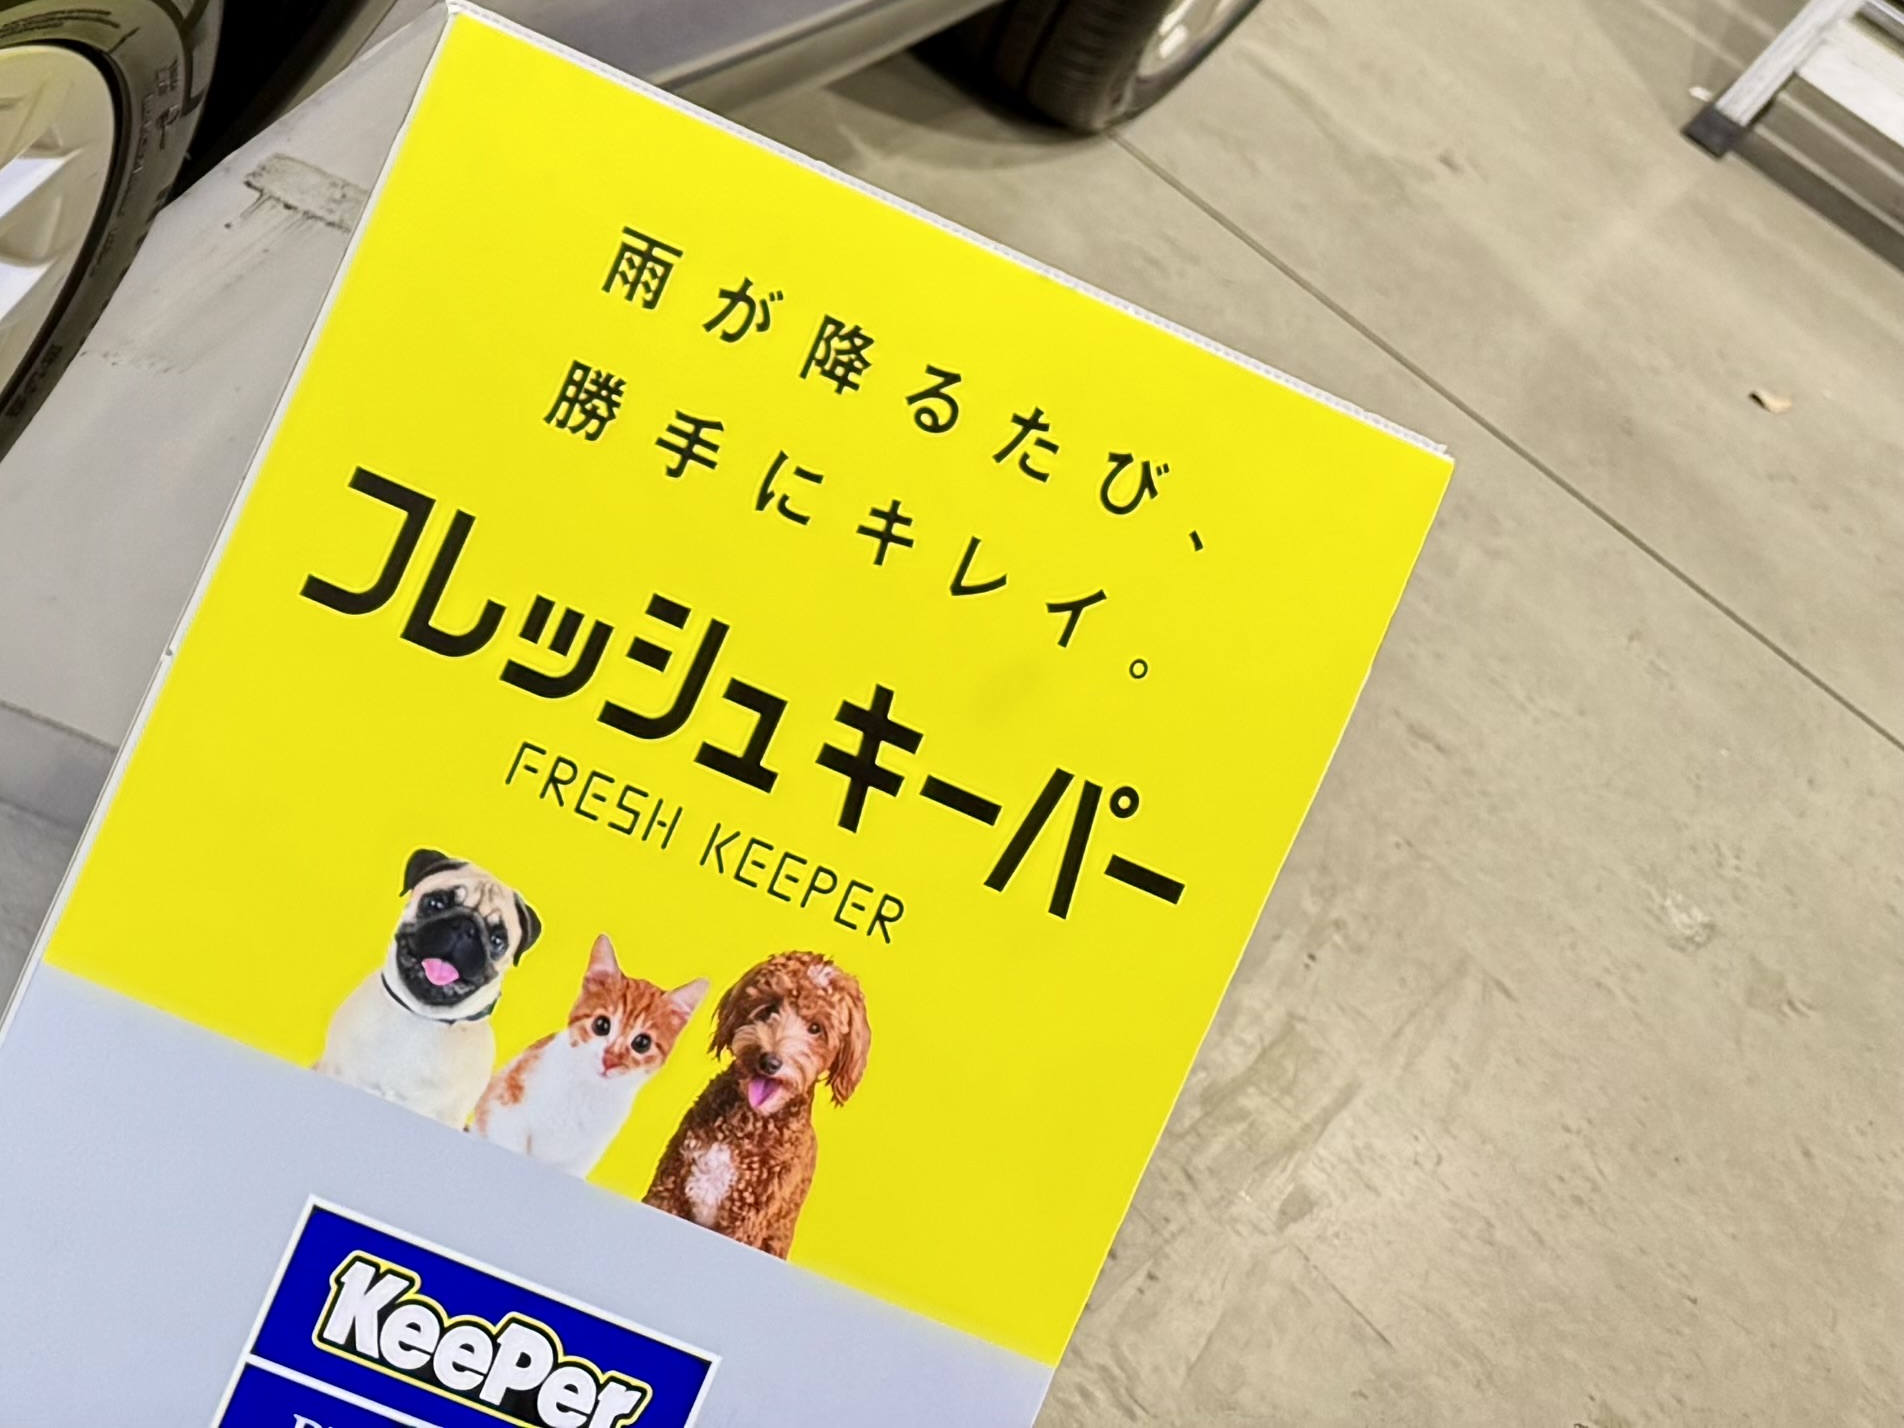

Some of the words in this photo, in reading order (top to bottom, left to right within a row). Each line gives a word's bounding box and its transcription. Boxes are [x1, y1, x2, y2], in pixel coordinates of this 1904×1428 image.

[543, 359, 1149, 681] 勝手にキレイ。
[601, 225, 1204, 553] 雨が降るたび、
[298, 466, 1186, 922] フレッシュキーパー
[504, 740, 684, 850] FRESH
[699, 821, 906, 945] KEEPER
[318, 1254, 647, 1428] KeePer
